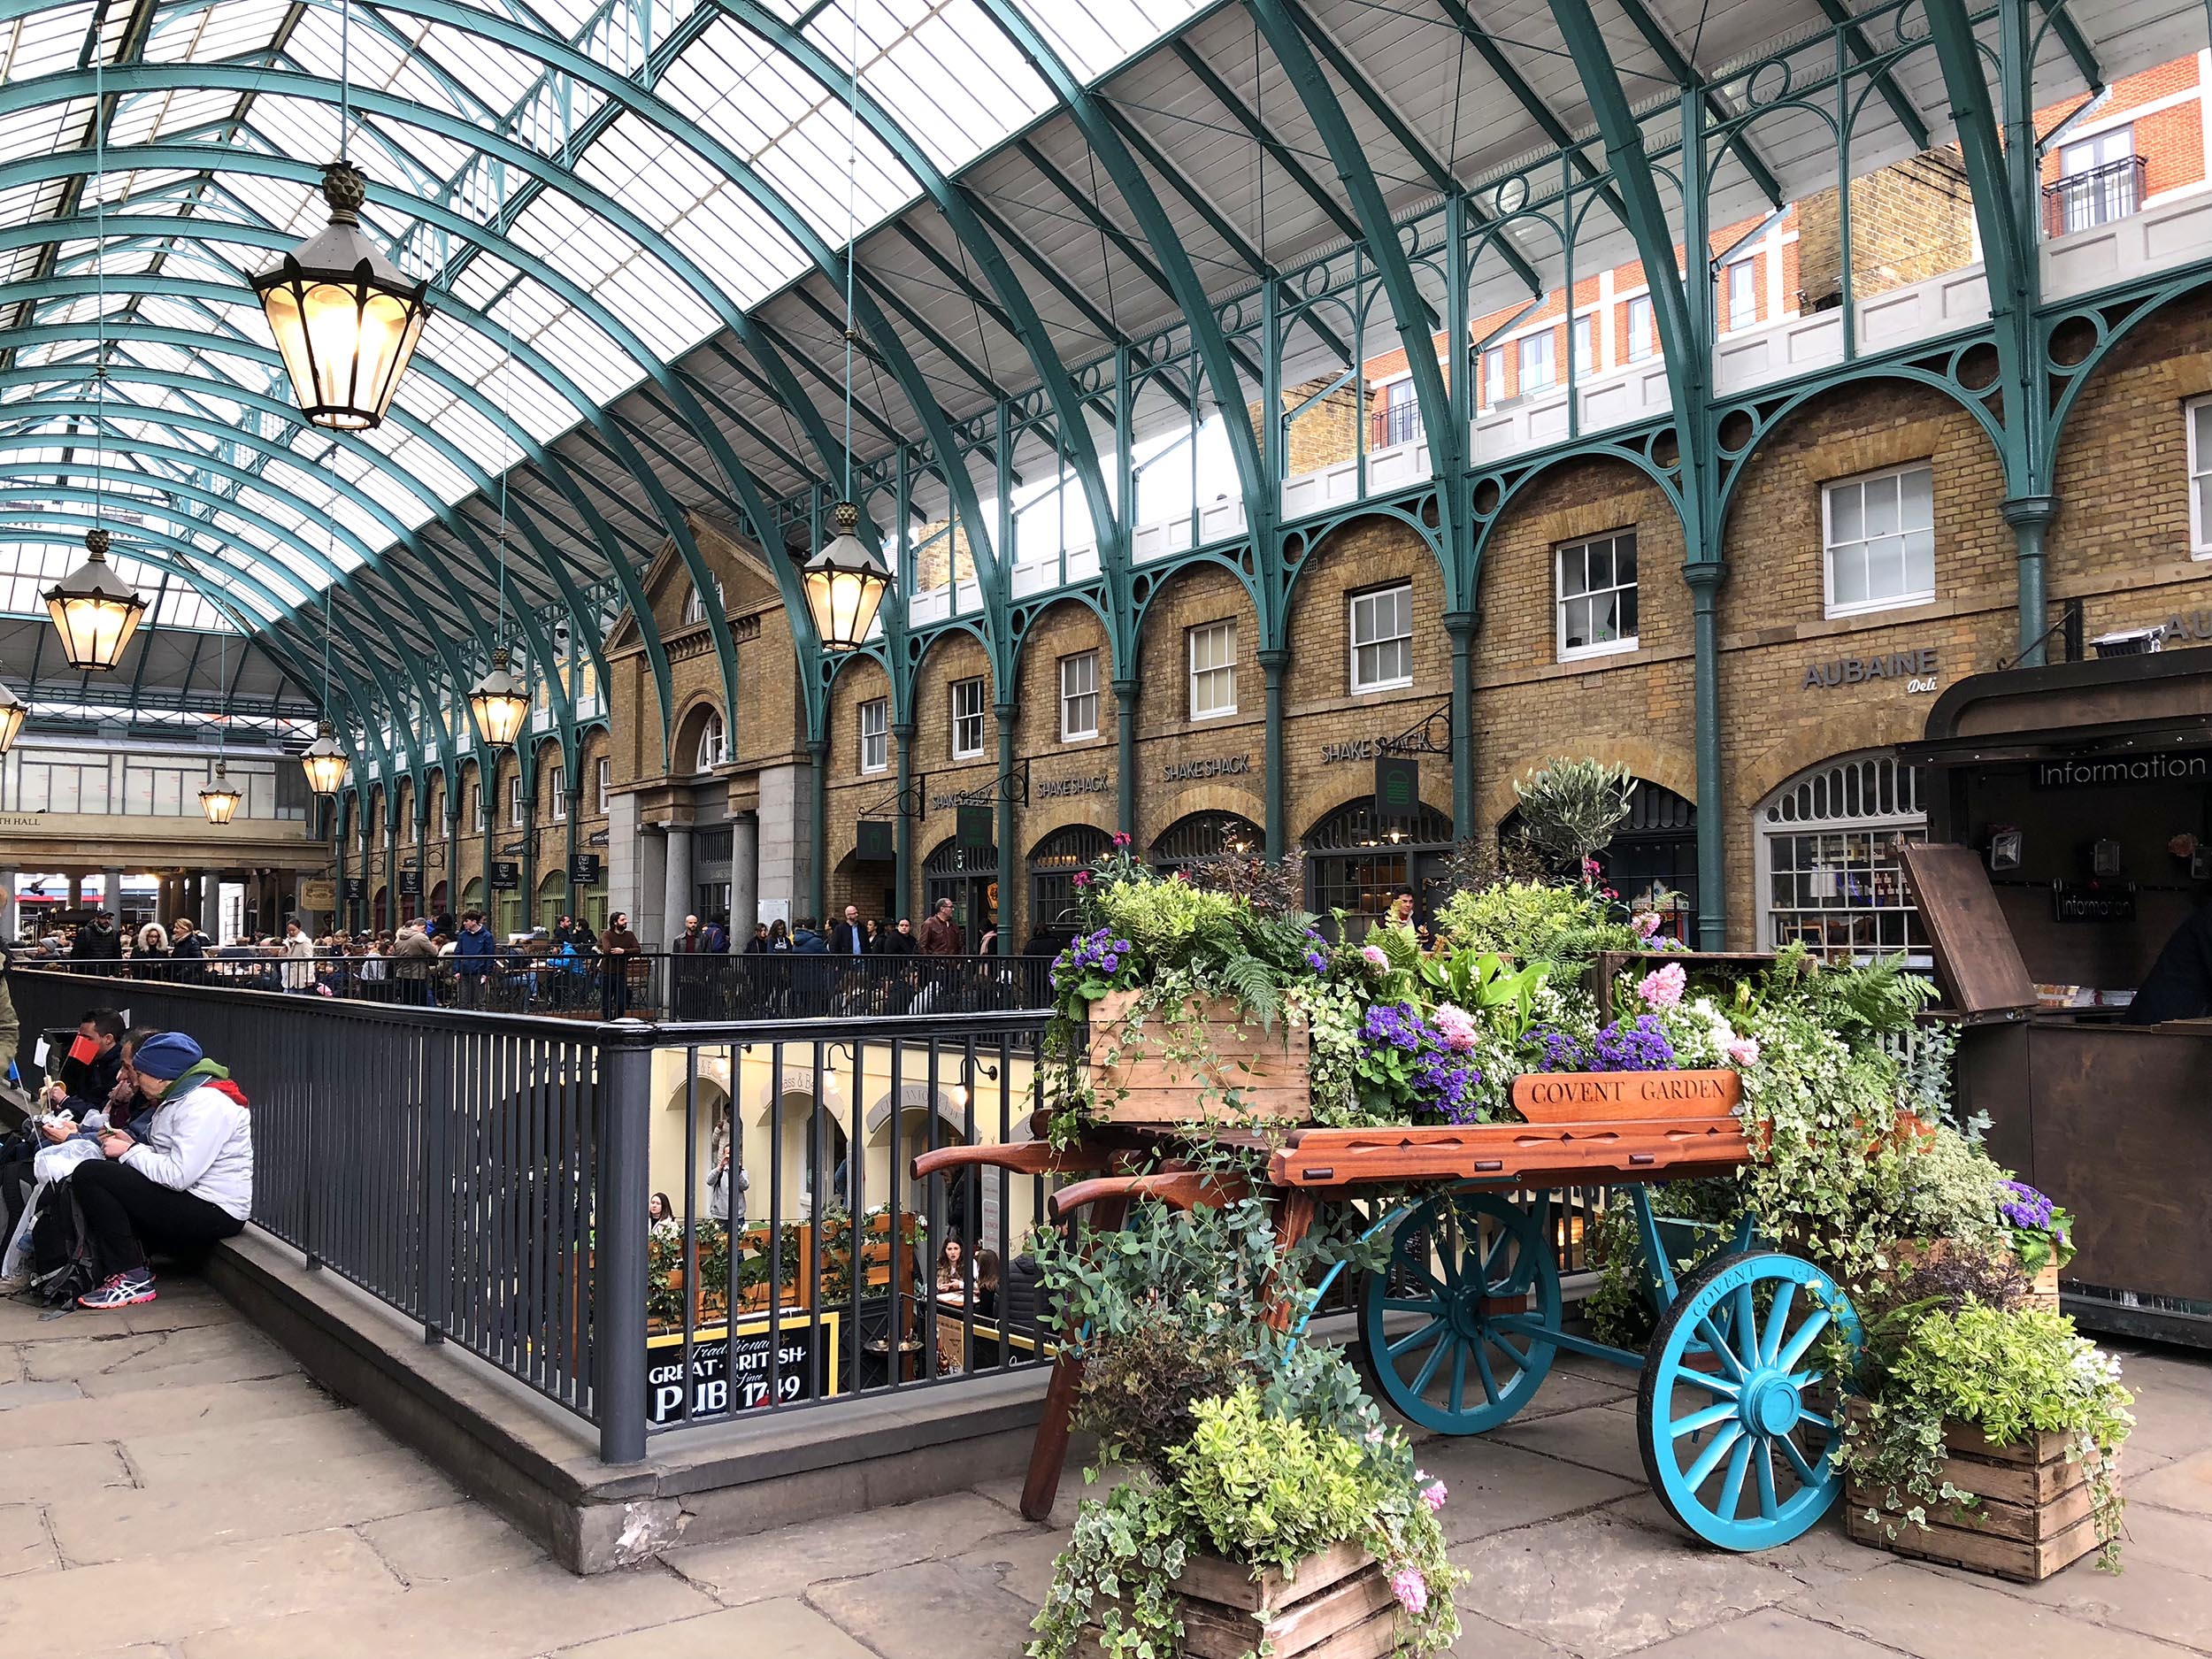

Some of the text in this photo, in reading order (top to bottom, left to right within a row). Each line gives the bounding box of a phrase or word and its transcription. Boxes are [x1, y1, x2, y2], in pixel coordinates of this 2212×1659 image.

[1802, 648, 1939, 689] AUBAINE
[1907, 677, 1938, 694] Deli
[1321, 740, 1371, 764] SHAKE
[1163, 755, 1248, 781] SHAKE SHACK
[2041, 755, 2206, 785] Information
[1037, 774, 1108, 798] SHAKE SHACK
[933, 793, 964, 810] SHAKE
[1531, 1079, 1726, 1104] COVENT GARDEN
[1694, 1263, 1756, 1317] COVENT
